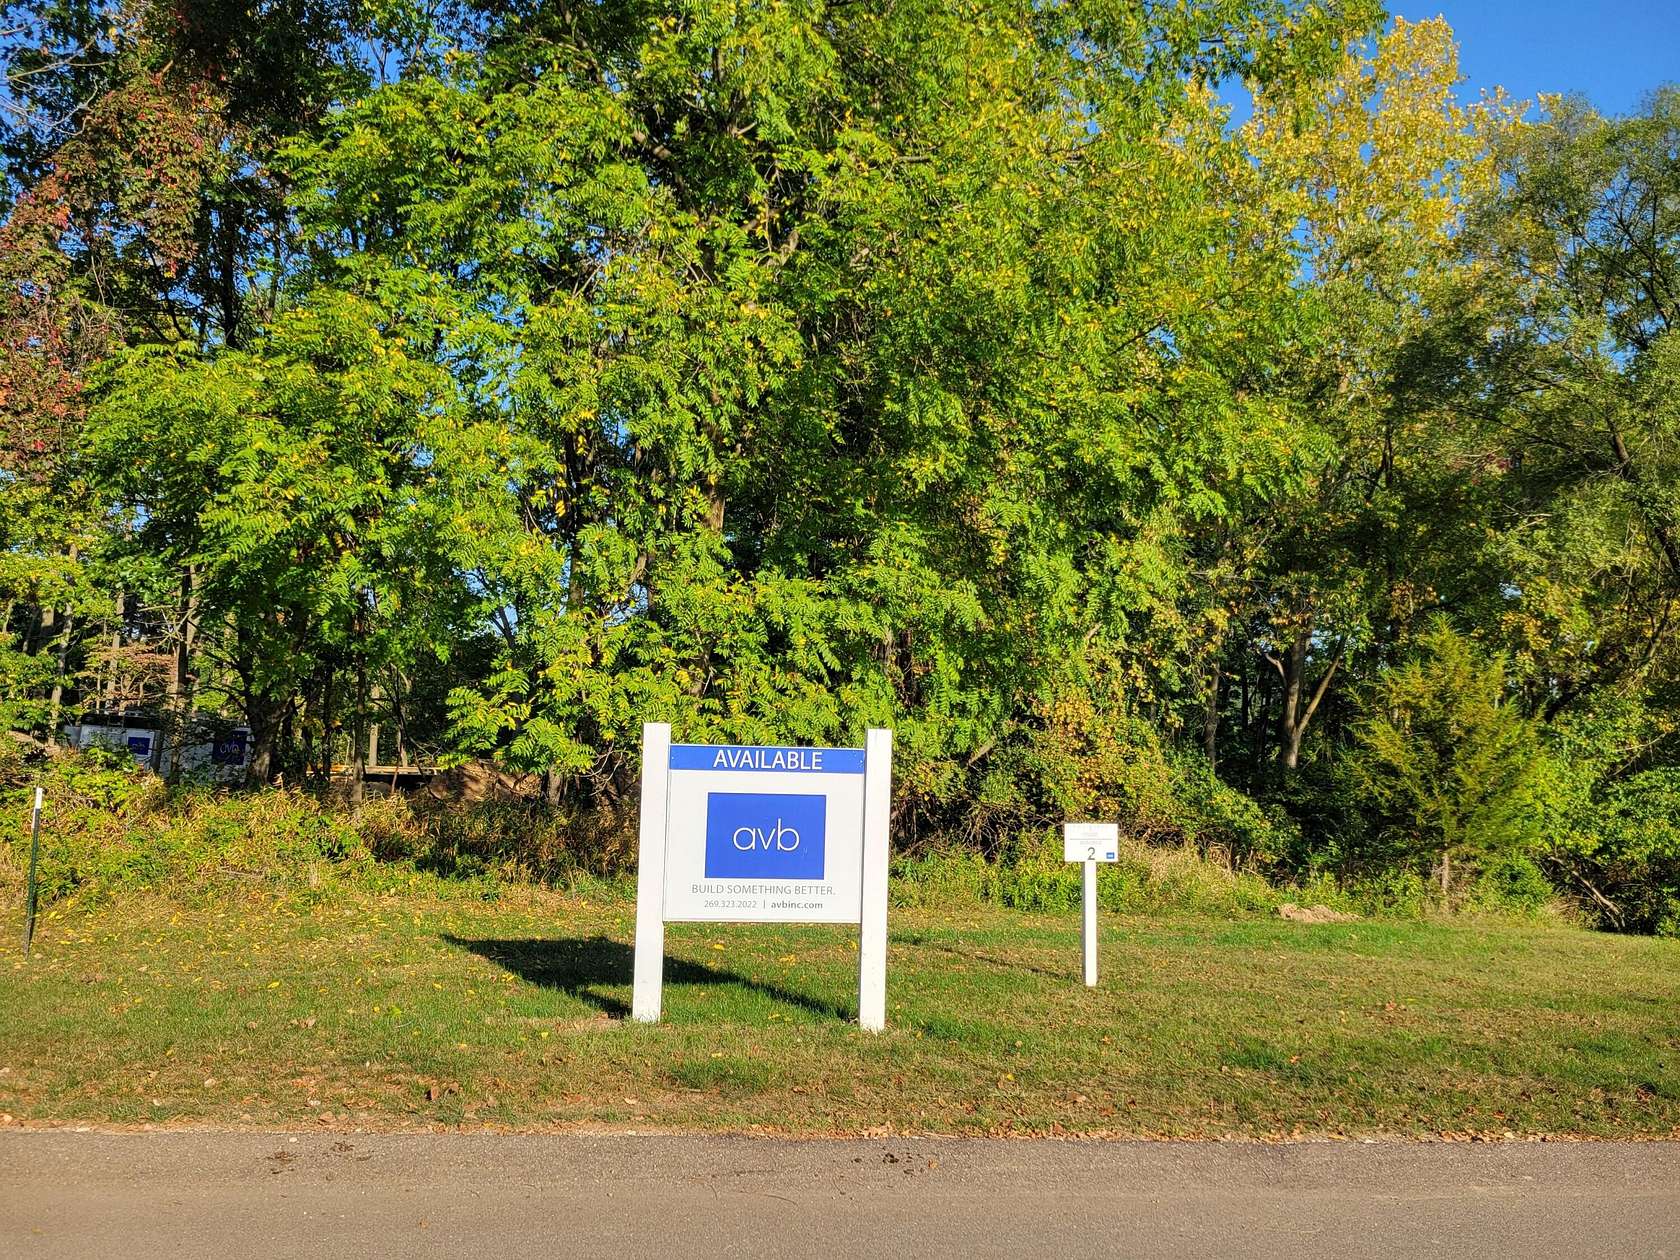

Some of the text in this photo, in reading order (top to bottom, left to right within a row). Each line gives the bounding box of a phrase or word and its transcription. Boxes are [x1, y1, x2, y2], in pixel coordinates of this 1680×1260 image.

[712, 749, 824, 770] AVAILABLE
[732, 817, 801, 852] avb
[1087, 846, 1096, 861] 2
[691, 883, 725, 895] BUILD
[727, 884, 792, 896] SOMETHING
[703, 899, 824, 910] 269.323.2022 avbinc.com
